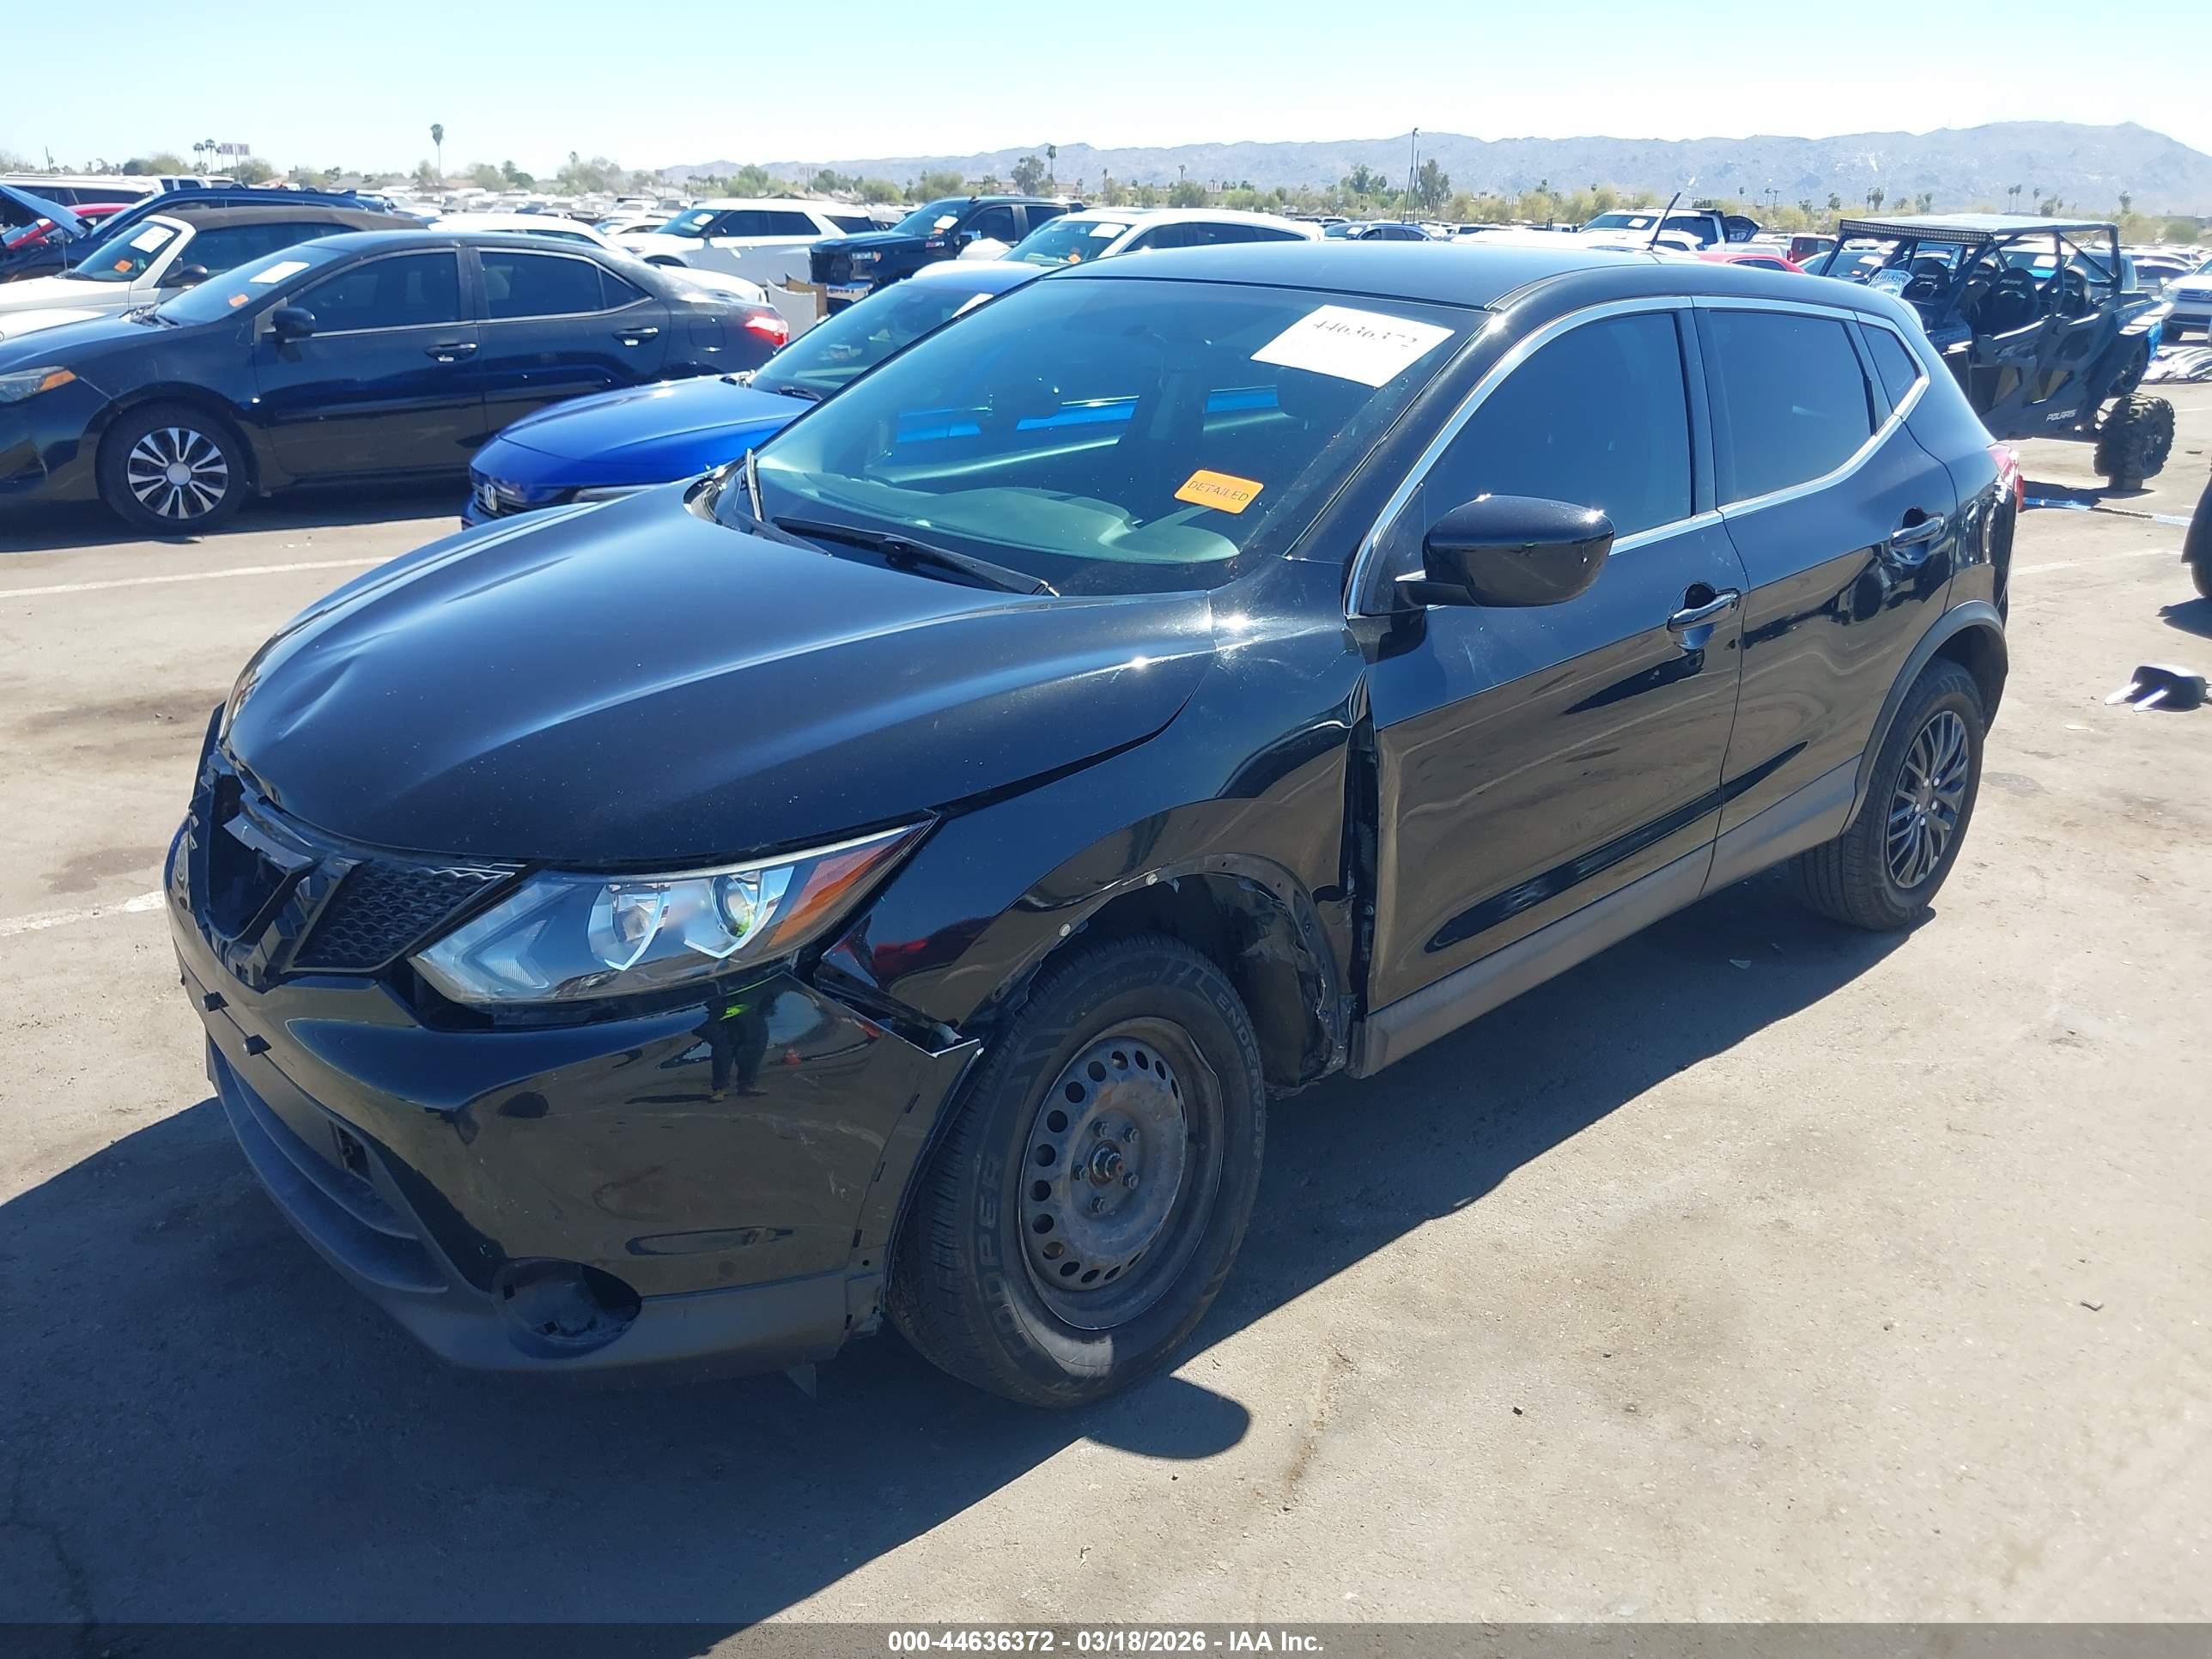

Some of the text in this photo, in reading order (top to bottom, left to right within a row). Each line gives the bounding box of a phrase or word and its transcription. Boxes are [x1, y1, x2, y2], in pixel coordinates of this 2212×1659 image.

[2045, 409, 2076, 422] POLARIS
[1188, 480, 1249, 501] DETAILED
[1216, 992, 1267, 1159] ENDEAVOR
[976, 1156, 1032, 1360] COOPER
